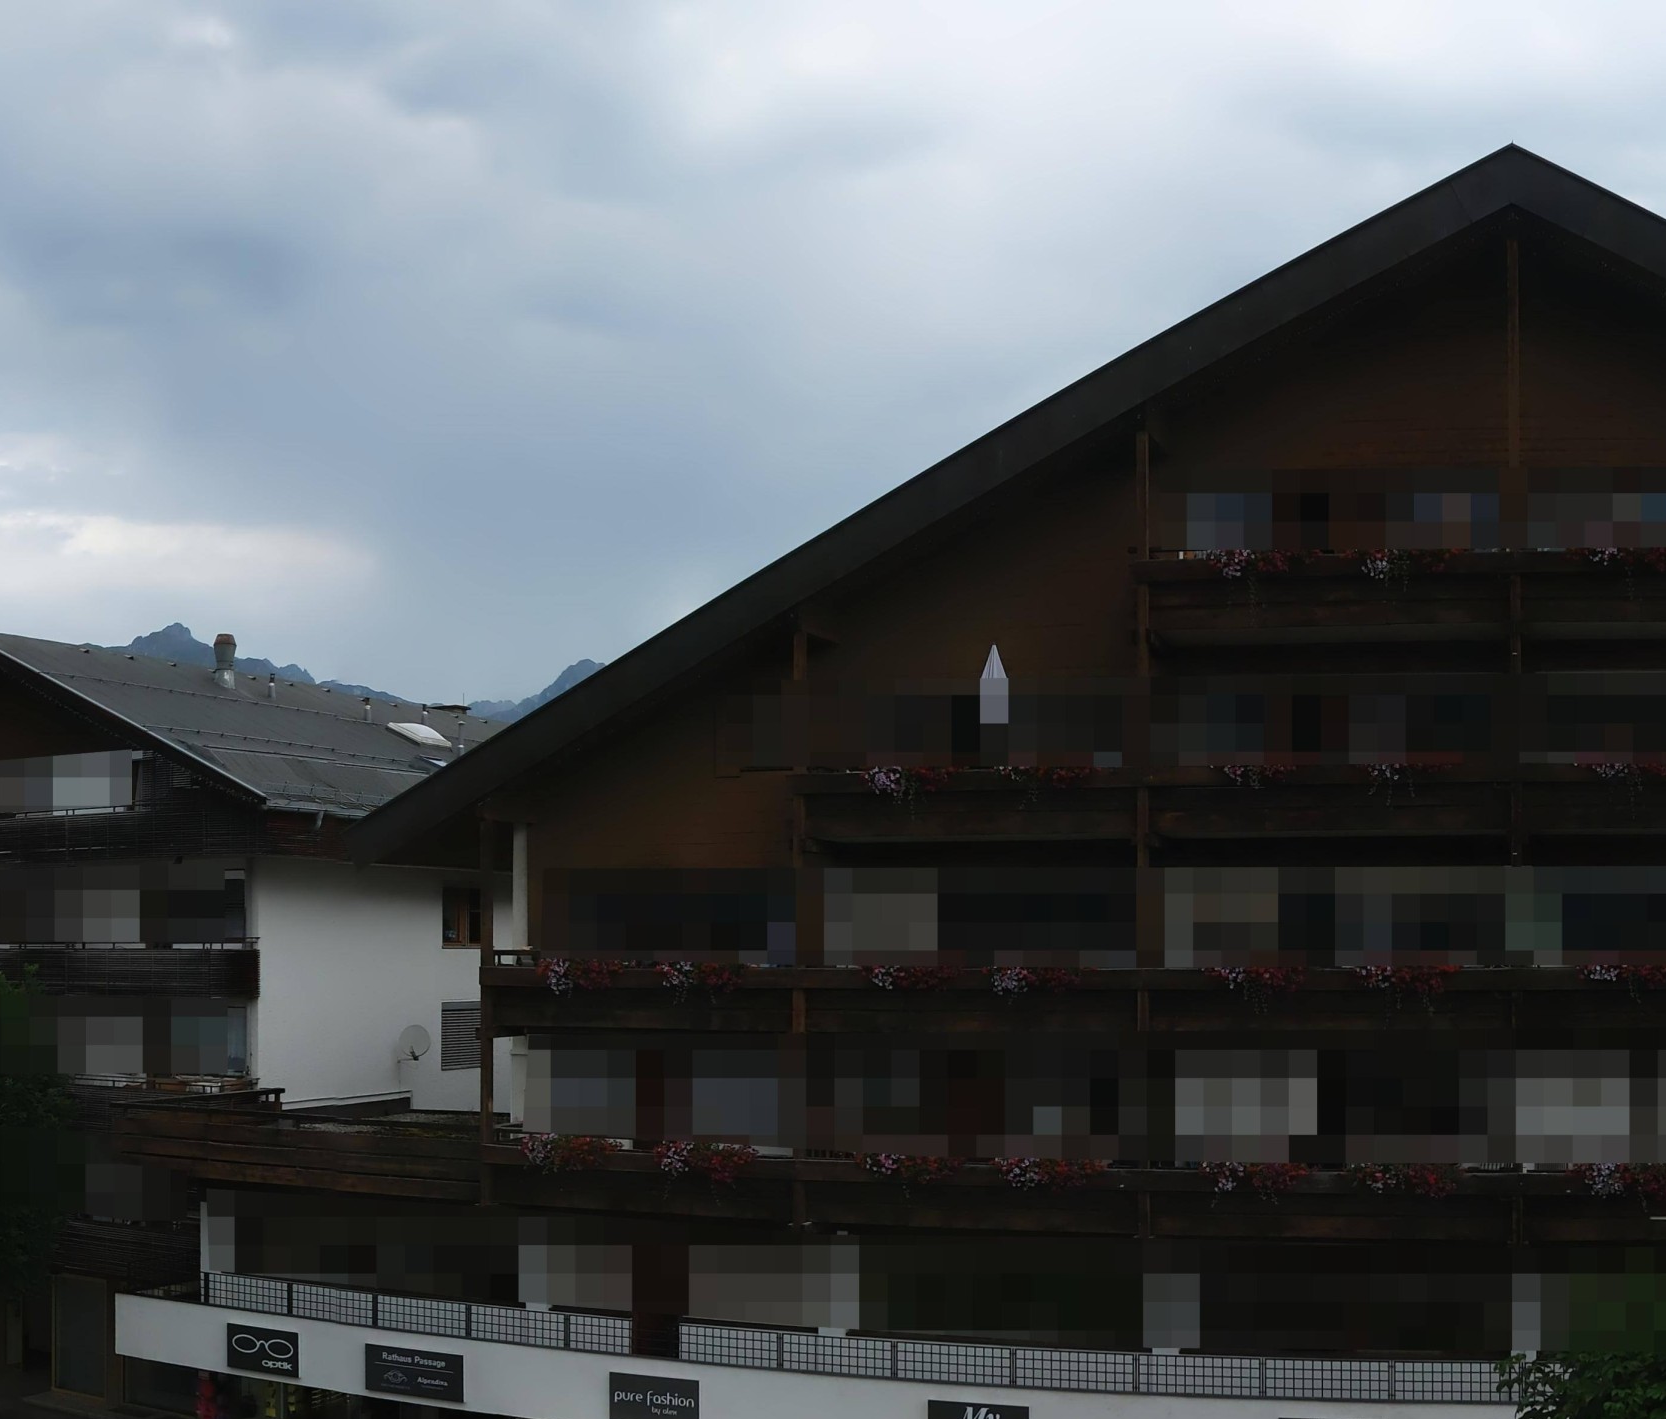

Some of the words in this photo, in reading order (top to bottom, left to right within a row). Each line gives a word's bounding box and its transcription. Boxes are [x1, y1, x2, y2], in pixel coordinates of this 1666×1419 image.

[261, 1359, 293, 1371] optik
[382, 1352, 412, 1363] Rathaus
[414, 1355, 446, 1368] Passage
[614, 1390, 643, 1406] pure
[646, 1390, 694, 1409] fashion
